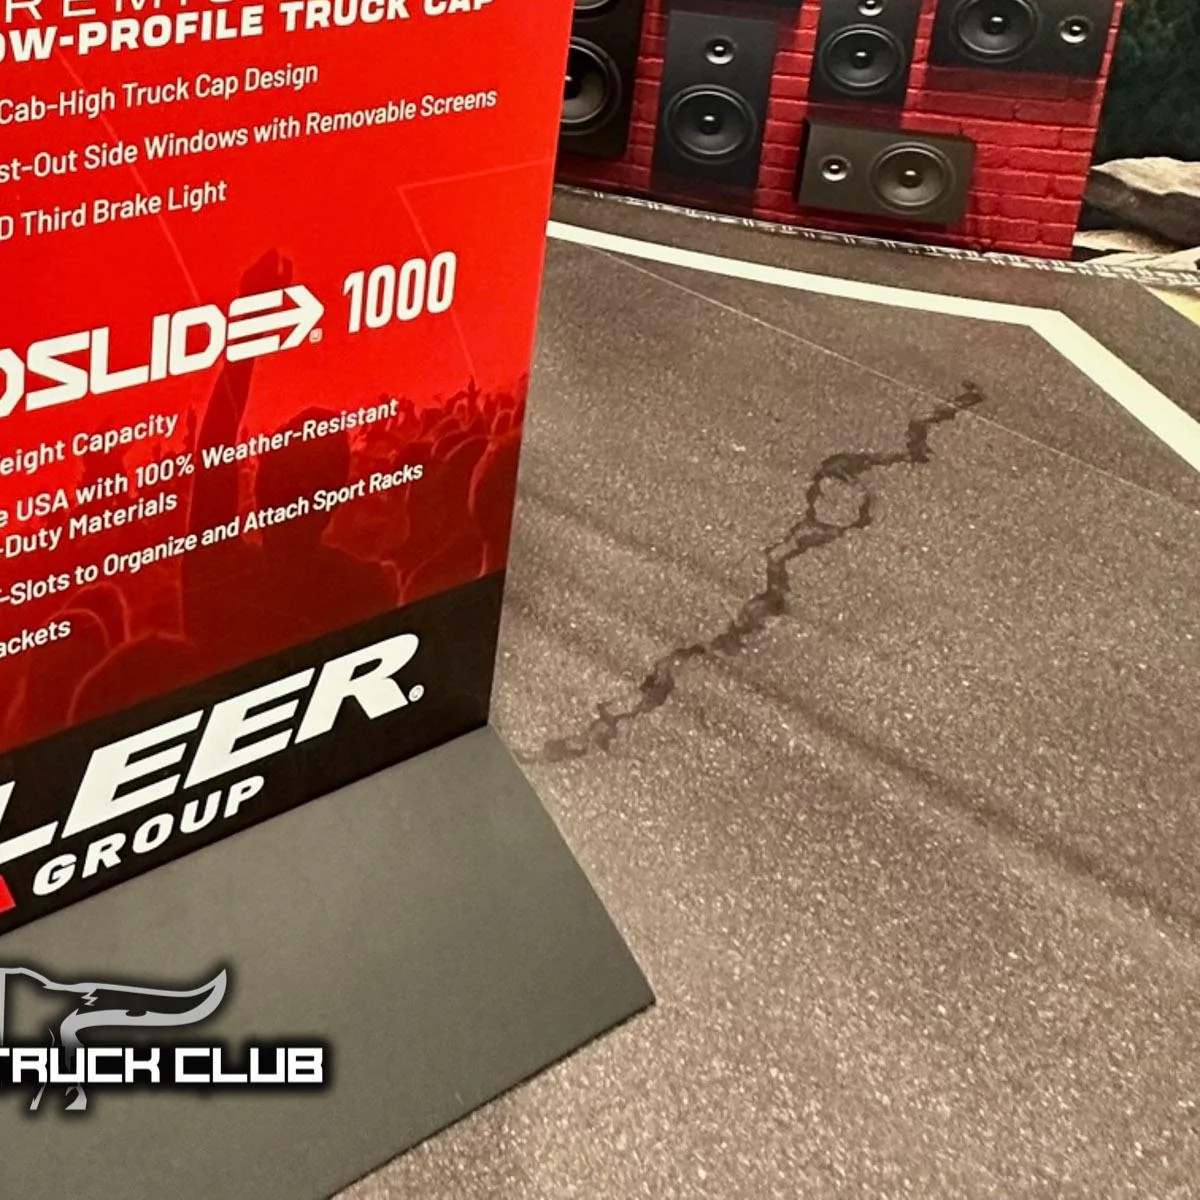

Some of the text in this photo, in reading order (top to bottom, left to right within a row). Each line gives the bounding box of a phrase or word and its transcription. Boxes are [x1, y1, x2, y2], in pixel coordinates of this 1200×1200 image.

[122, 77, 189, 106] Truck
[195, 73, 239, 99] Cap
[245, 63, 319, 91] Design
[84, 143, 138, 170] Side
[144, 126, 249, 160] Windows
[253, 115, 300, 144] with
[305, 99, 417, 135] Removable
[420, 89, 498, 117] Screens
[21, 202, 87, 236] Third
[93, 192, 162, 224] Brake
[167, 181, 228, 212] Light
[342, 251, 458, 333] 1000
[16, 489, 69, 522] USA
[76, 474, 128, 508] with
[135, 453, 195, 488] 100%
[202, 398, 398, 470] Weather-Resistant
[72, 413, 179, 456] Capacity
[68, 492, 179, 540] Materials
[74, 565, 98, 586] to
[103, 534, 198, 577] Organize
[201, 516, 240, 545] and
[243, 496, 309, 533] Attach
[313, 479, 366, 512] Sport
[368, 463, 424, 494] Racks
[32, 775, 265, 897] GROUP
